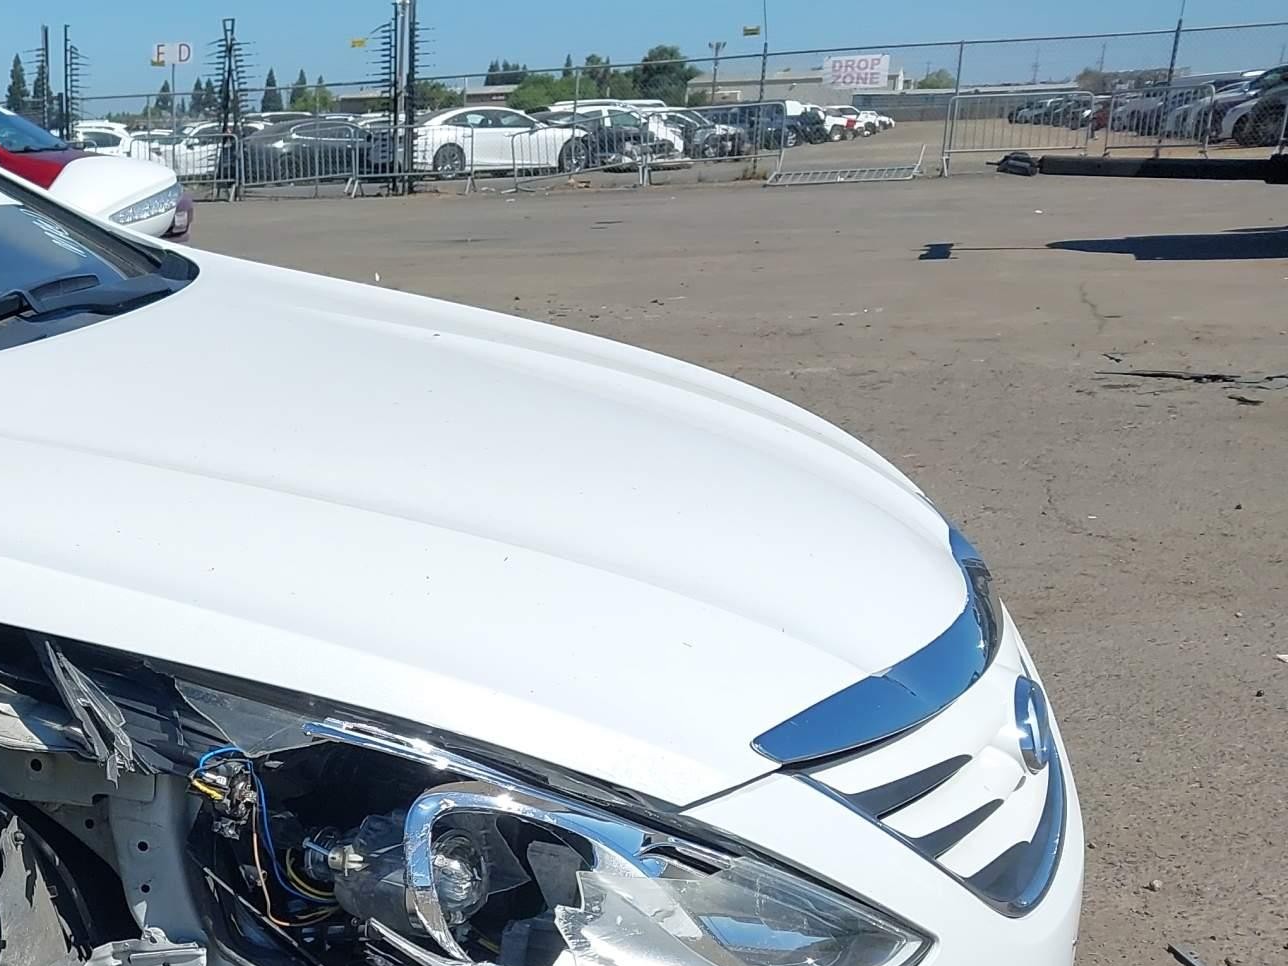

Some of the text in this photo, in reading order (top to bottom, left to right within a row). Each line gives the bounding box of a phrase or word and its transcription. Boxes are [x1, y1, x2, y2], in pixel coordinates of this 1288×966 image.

[178, 43, 192, 62] D
[831, 57, 881, 72] DROP
[831, 72, 881, 85] ZONE
